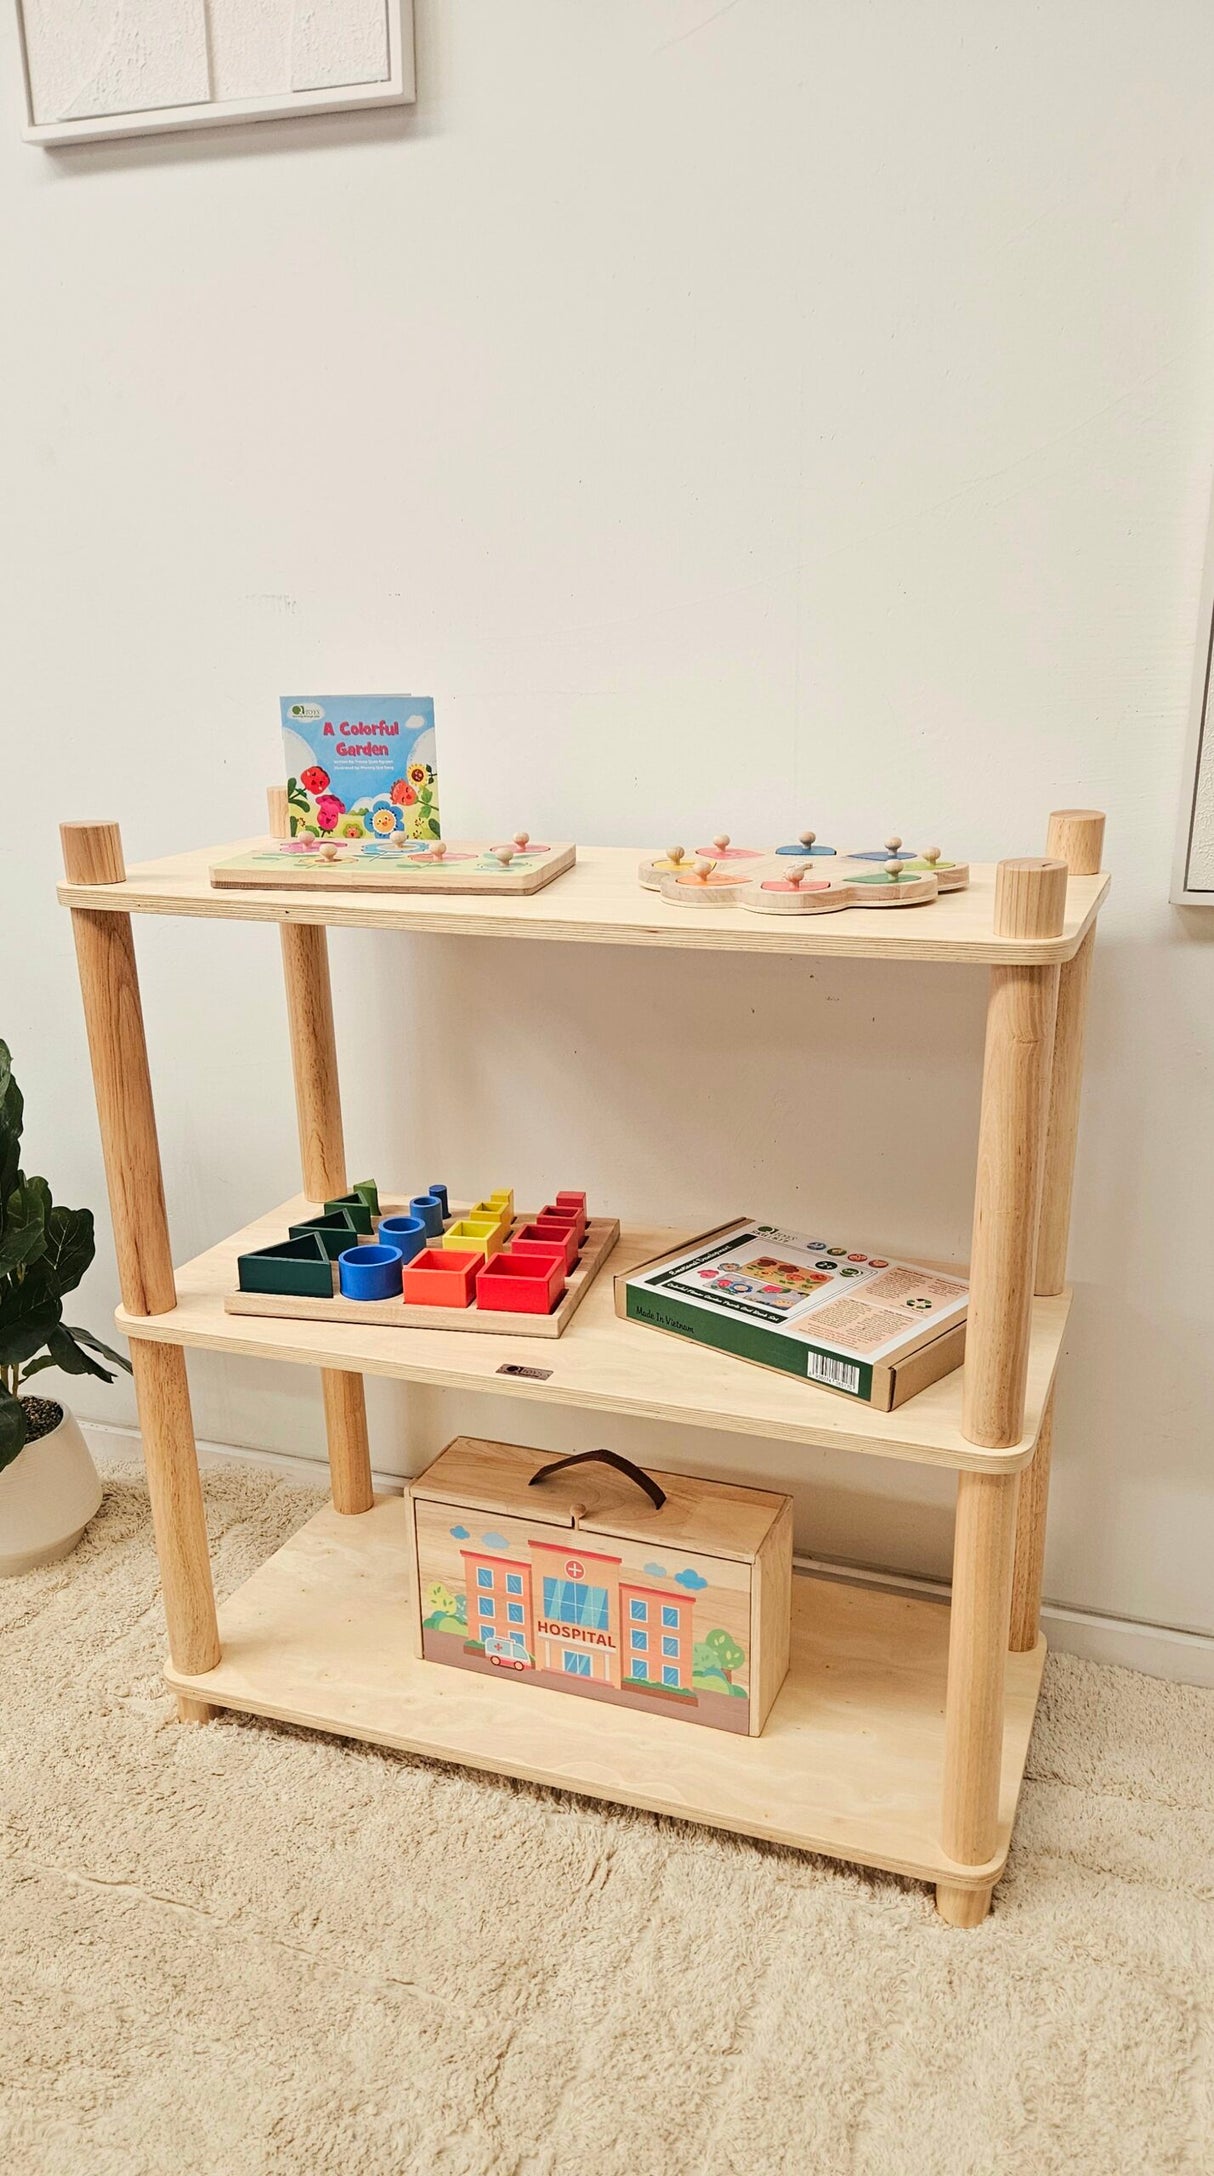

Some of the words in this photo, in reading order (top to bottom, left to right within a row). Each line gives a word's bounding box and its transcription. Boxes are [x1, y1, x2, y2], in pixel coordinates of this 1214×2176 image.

[323, 722, 335, 736] A
[339, 720, 400, 737] Colorful
[336, 741, 390, 757] Garden
[636, 1305, 655, 1320] Made
[656, 1311, 665, 1324] In
[665, 1314, 695, 1334] Vietnam
[537, 1620, 617, 1649] HOSPITAL
